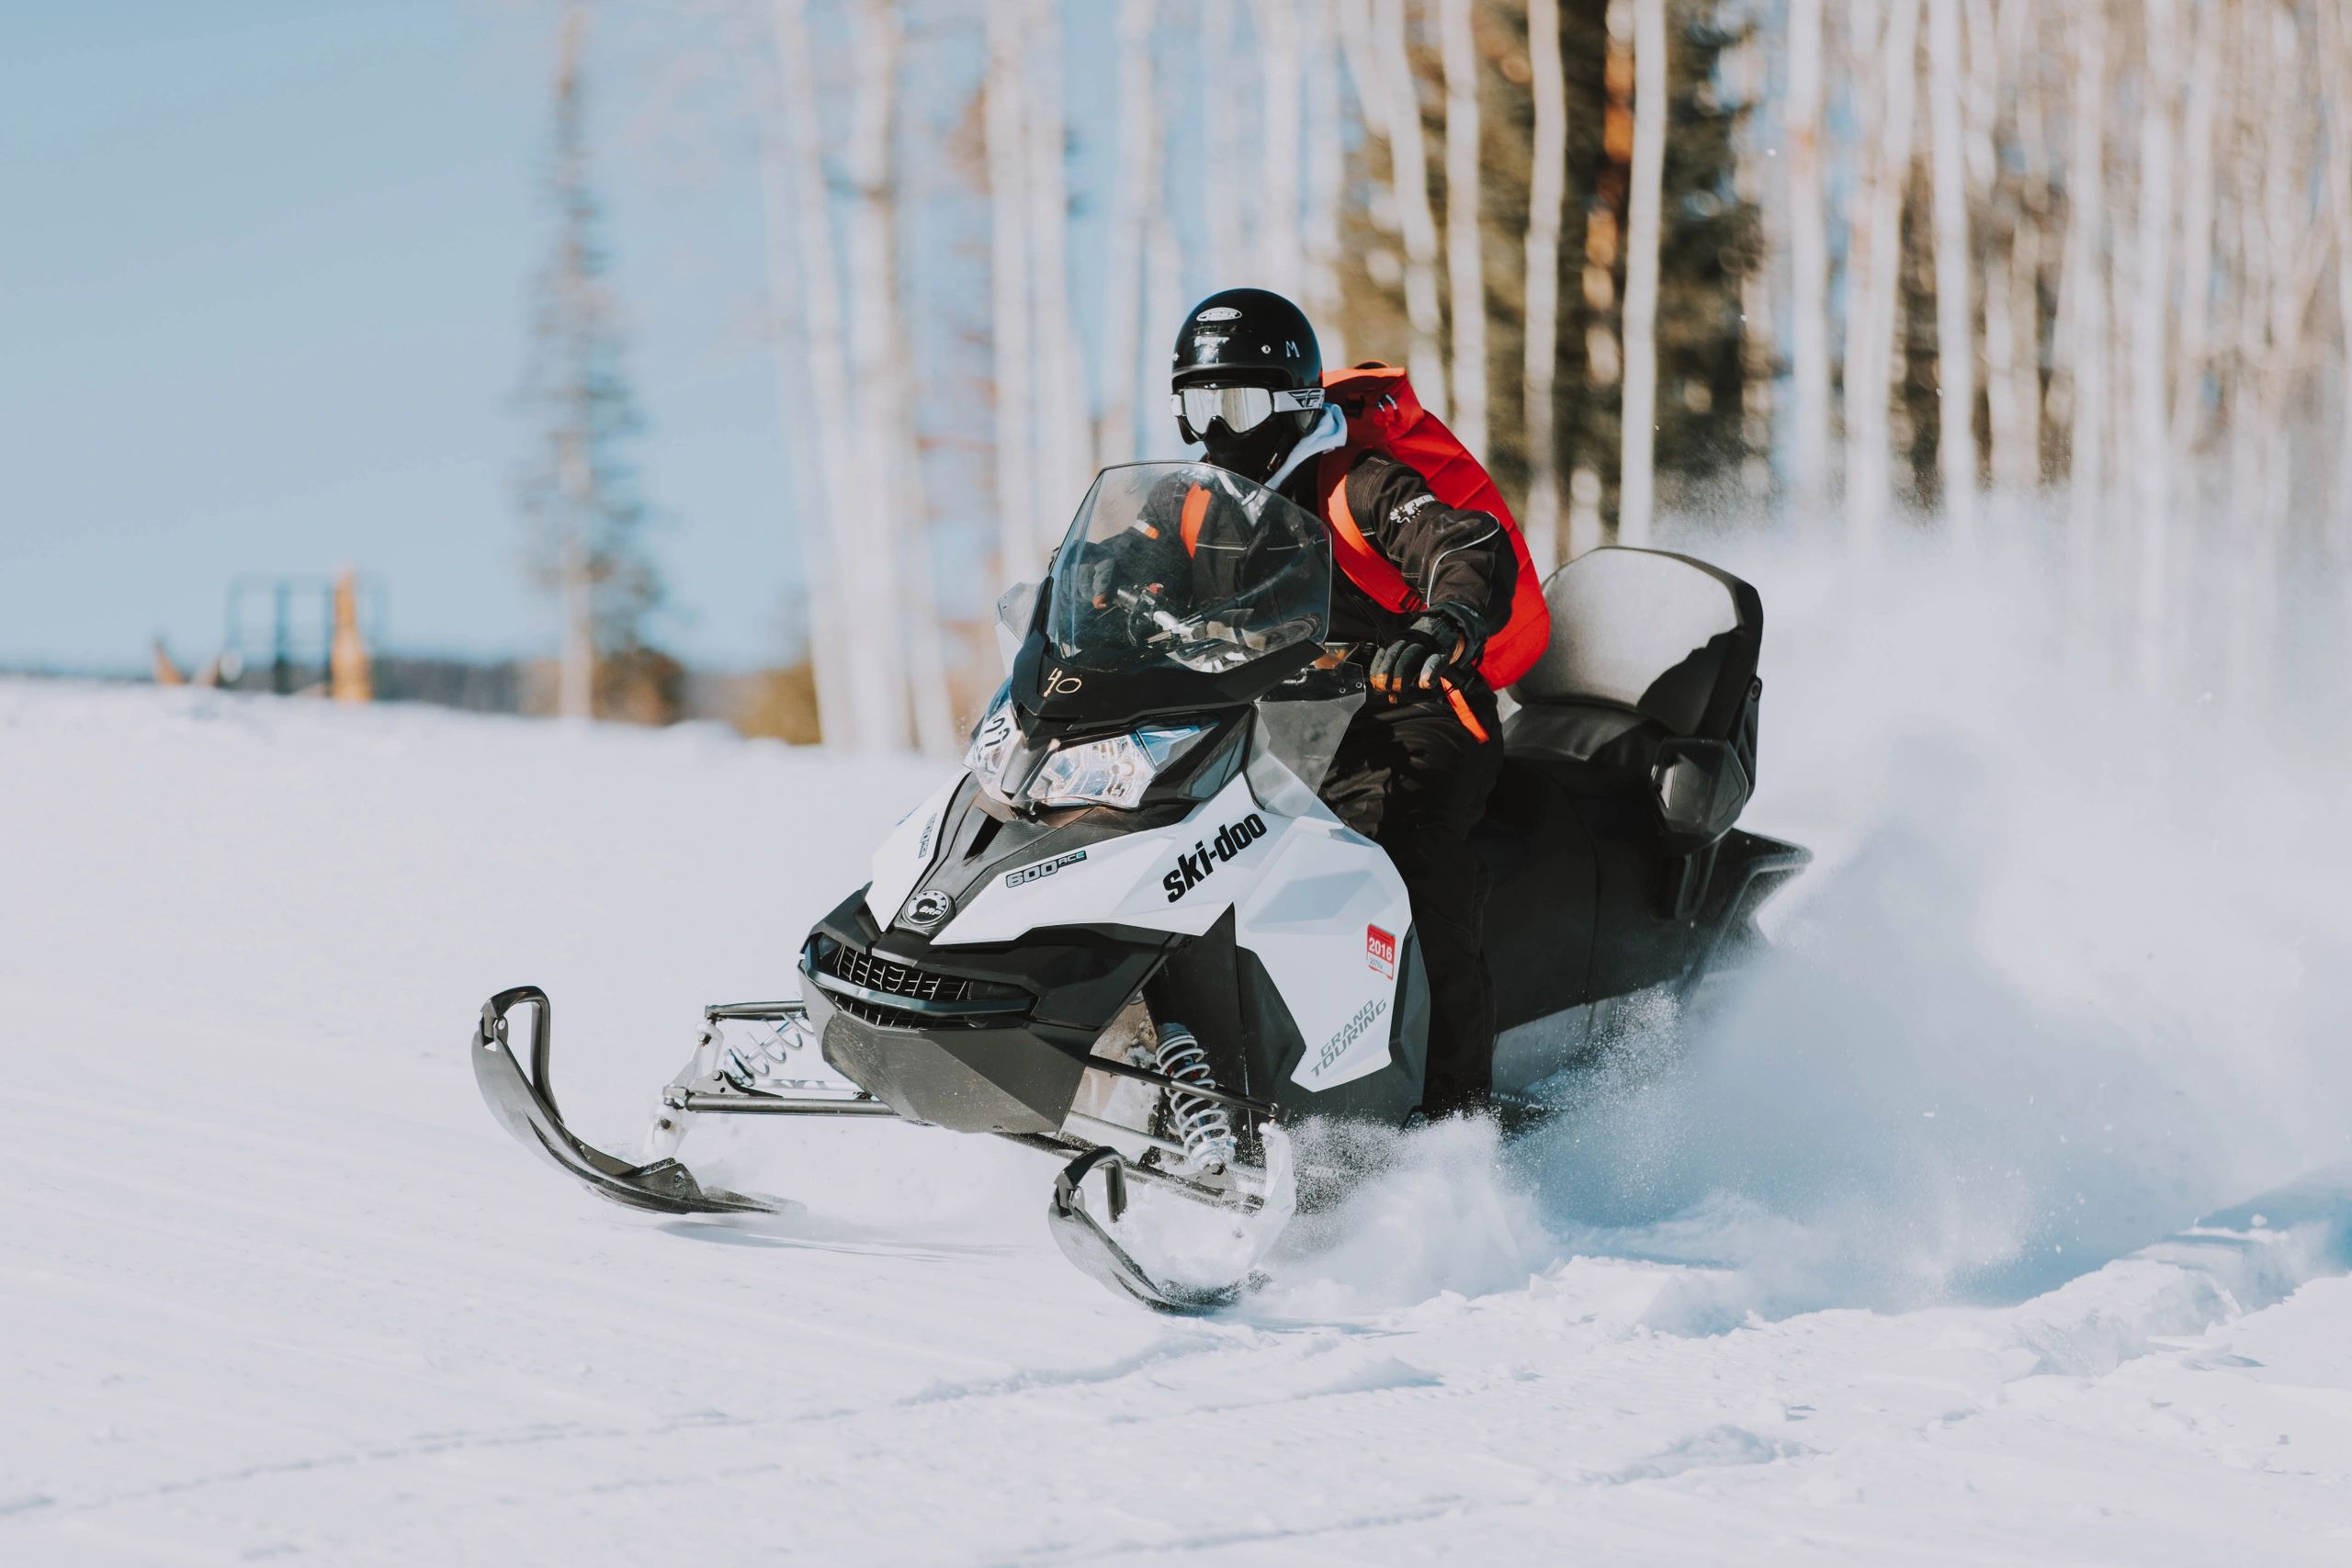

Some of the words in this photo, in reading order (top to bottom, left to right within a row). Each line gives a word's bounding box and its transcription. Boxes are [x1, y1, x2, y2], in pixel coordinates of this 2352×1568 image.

[1043, 667, 1082, 698] 40
[1162, 813, 1268, 903] ski-doo
[918, 905, 943, 916] BRP
[1368, 936, 1394, 963] 2016
[1310, 998, 1386, 1077] TOURING
[1320, 998, 1374, 1057] GRAND
